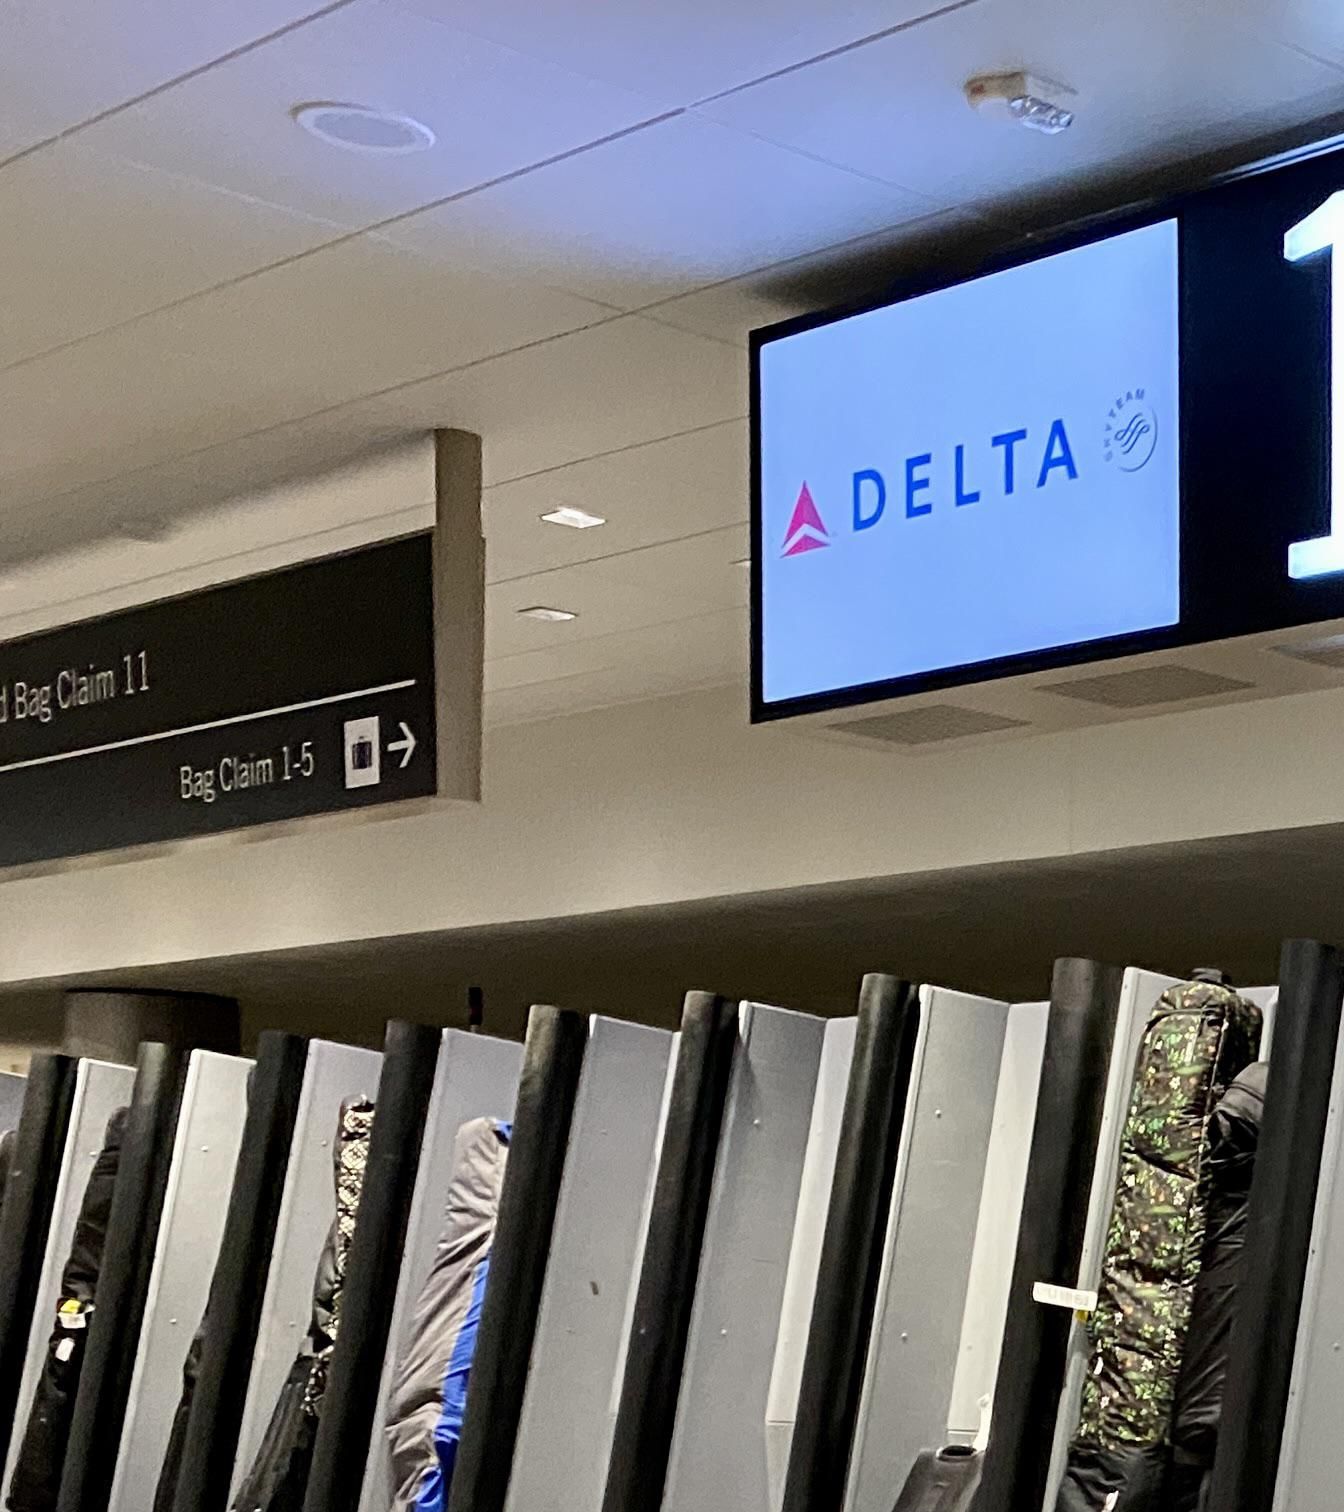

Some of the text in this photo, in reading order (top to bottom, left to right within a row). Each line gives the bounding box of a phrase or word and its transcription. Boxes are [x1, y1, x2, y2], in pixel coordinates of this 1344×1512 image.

[852, 418, 1079, 532] DELTA
[14, 681, 52, 723] Bag
[57, 663, 115, 710] Claim
[123, 650, 149, 695] 11
[179, 741, 315, 803] Bag Claim 1-5
